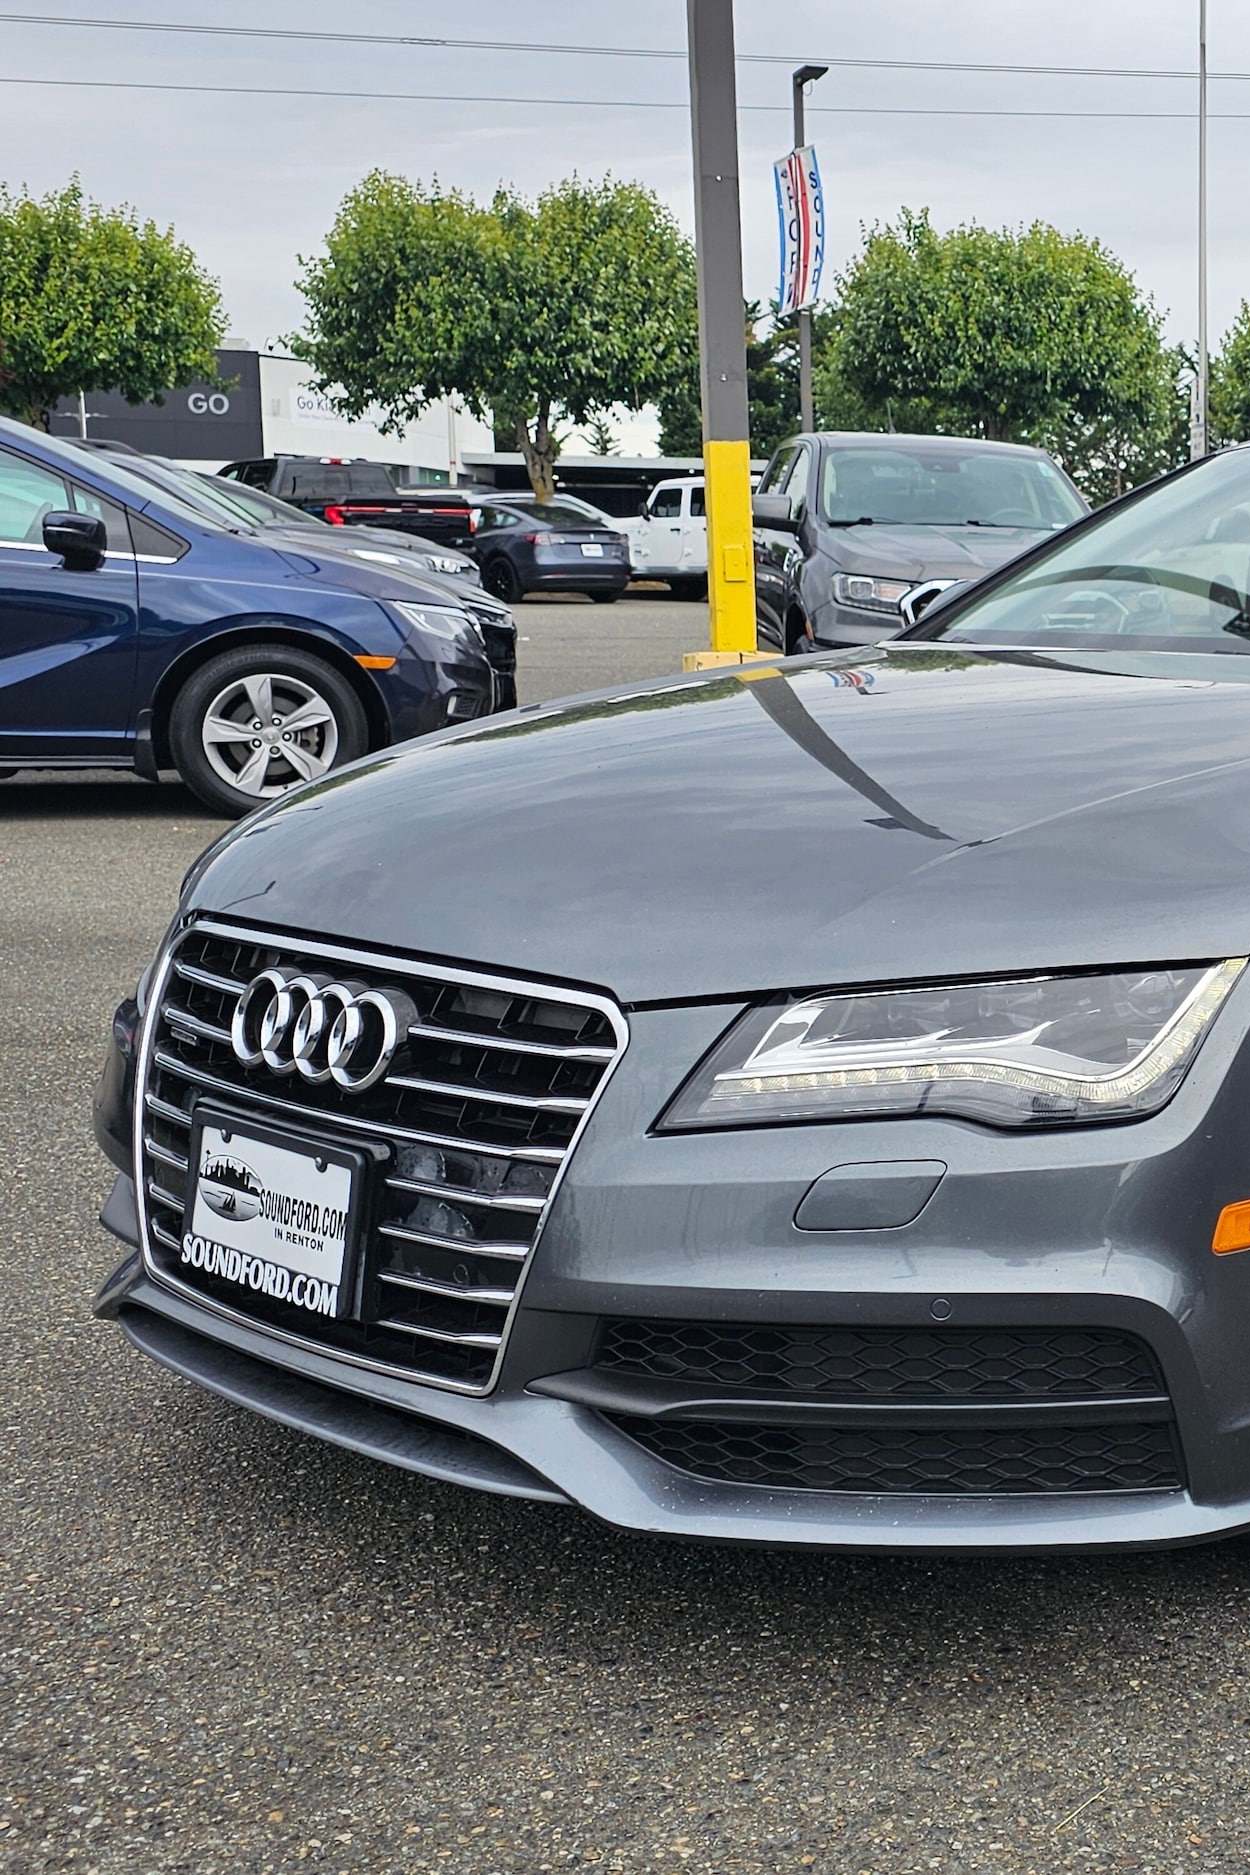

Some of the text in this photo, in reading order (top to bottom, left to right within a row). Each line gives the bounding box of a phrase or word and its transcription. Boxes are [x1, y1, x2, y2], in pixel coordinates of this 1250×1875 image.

[188, 393, 229, 415] GO
[297, 396, 313, 410] Go
[258, 1188, 349, 1242] SOUNDFORD.COM
[275, 1228, 324, 1252] IN RENTON
[181, 1233, 339, 1318] SOUNDFORD.COM
